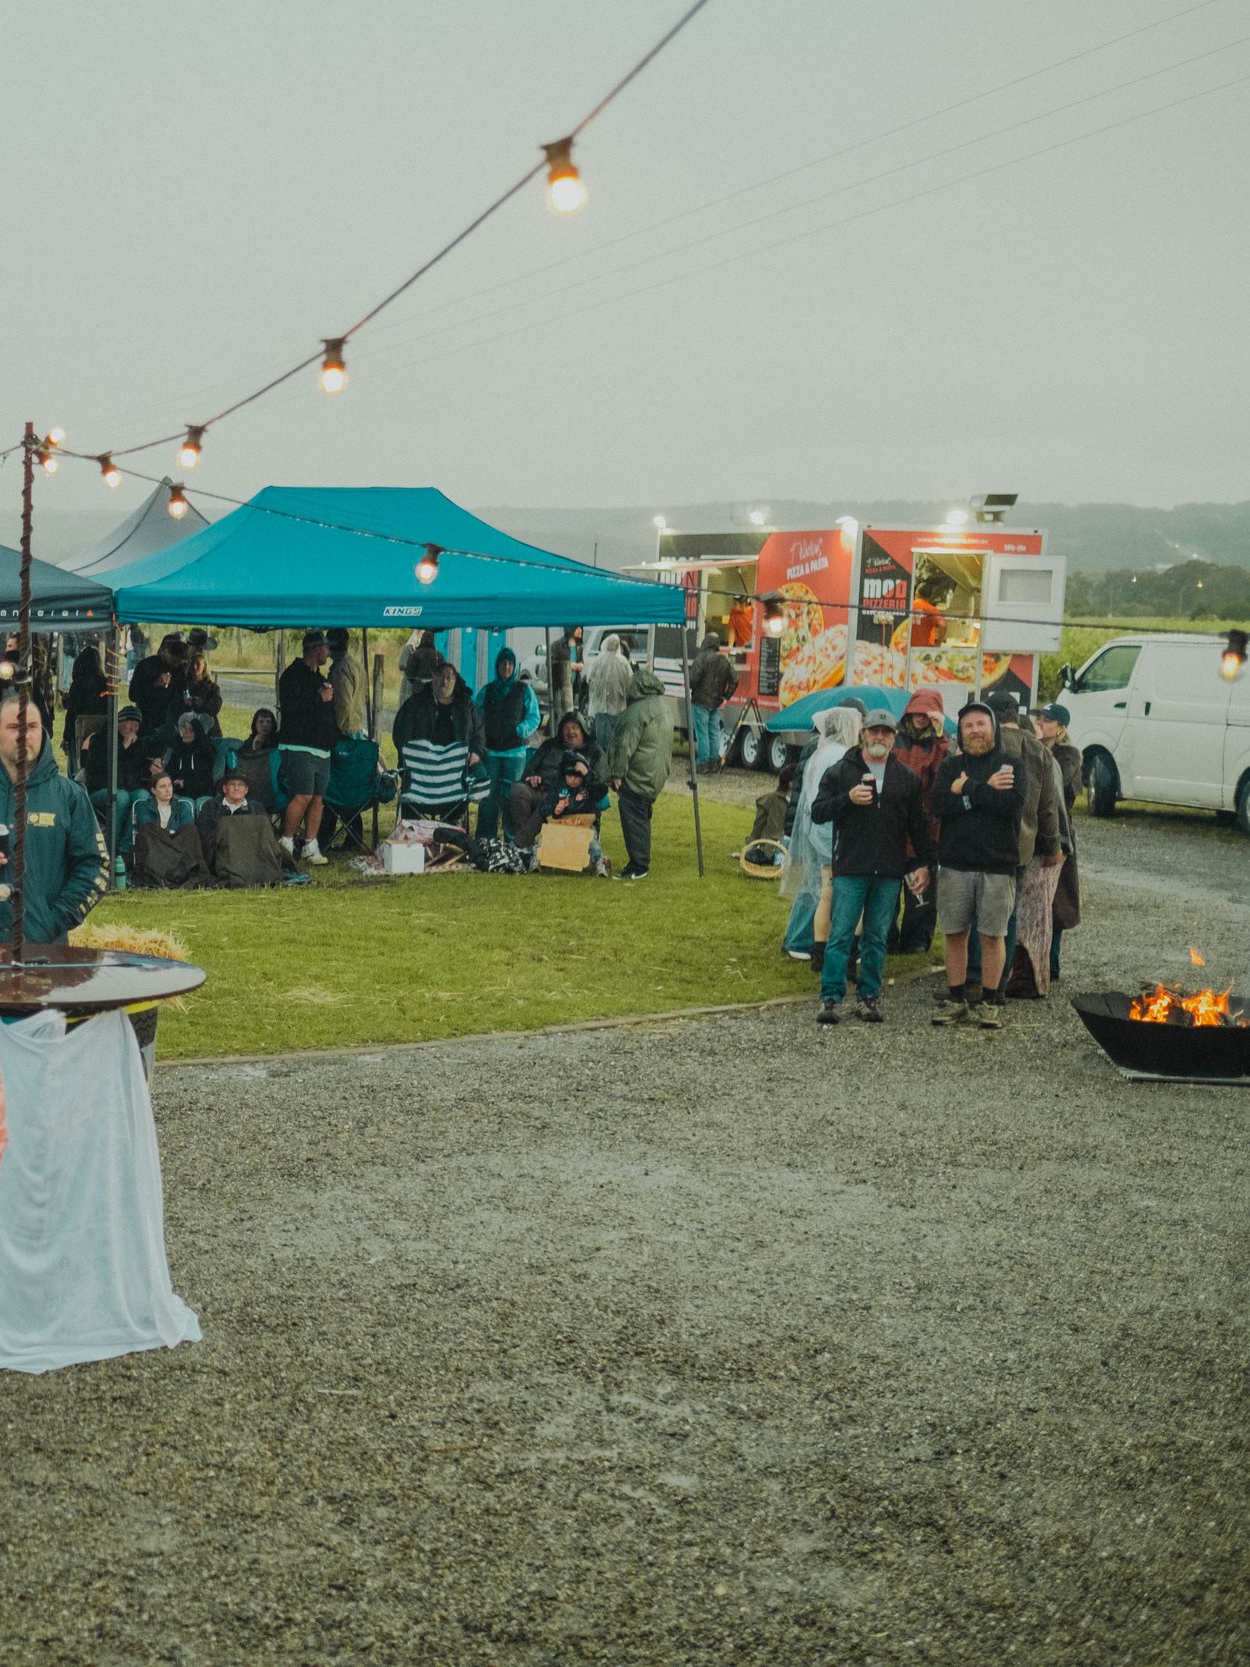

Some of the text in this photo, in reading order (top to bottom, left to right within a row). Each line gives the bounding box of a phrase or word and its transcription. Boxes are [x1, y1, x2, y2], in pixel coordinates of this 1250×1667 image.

[786, 563, 805, 581] PIZZA
[810, 556, 830, 573] PASTA
[861, 598, 907, 609] PIZZERIA
[383, 606, 423, 616] KINGS
